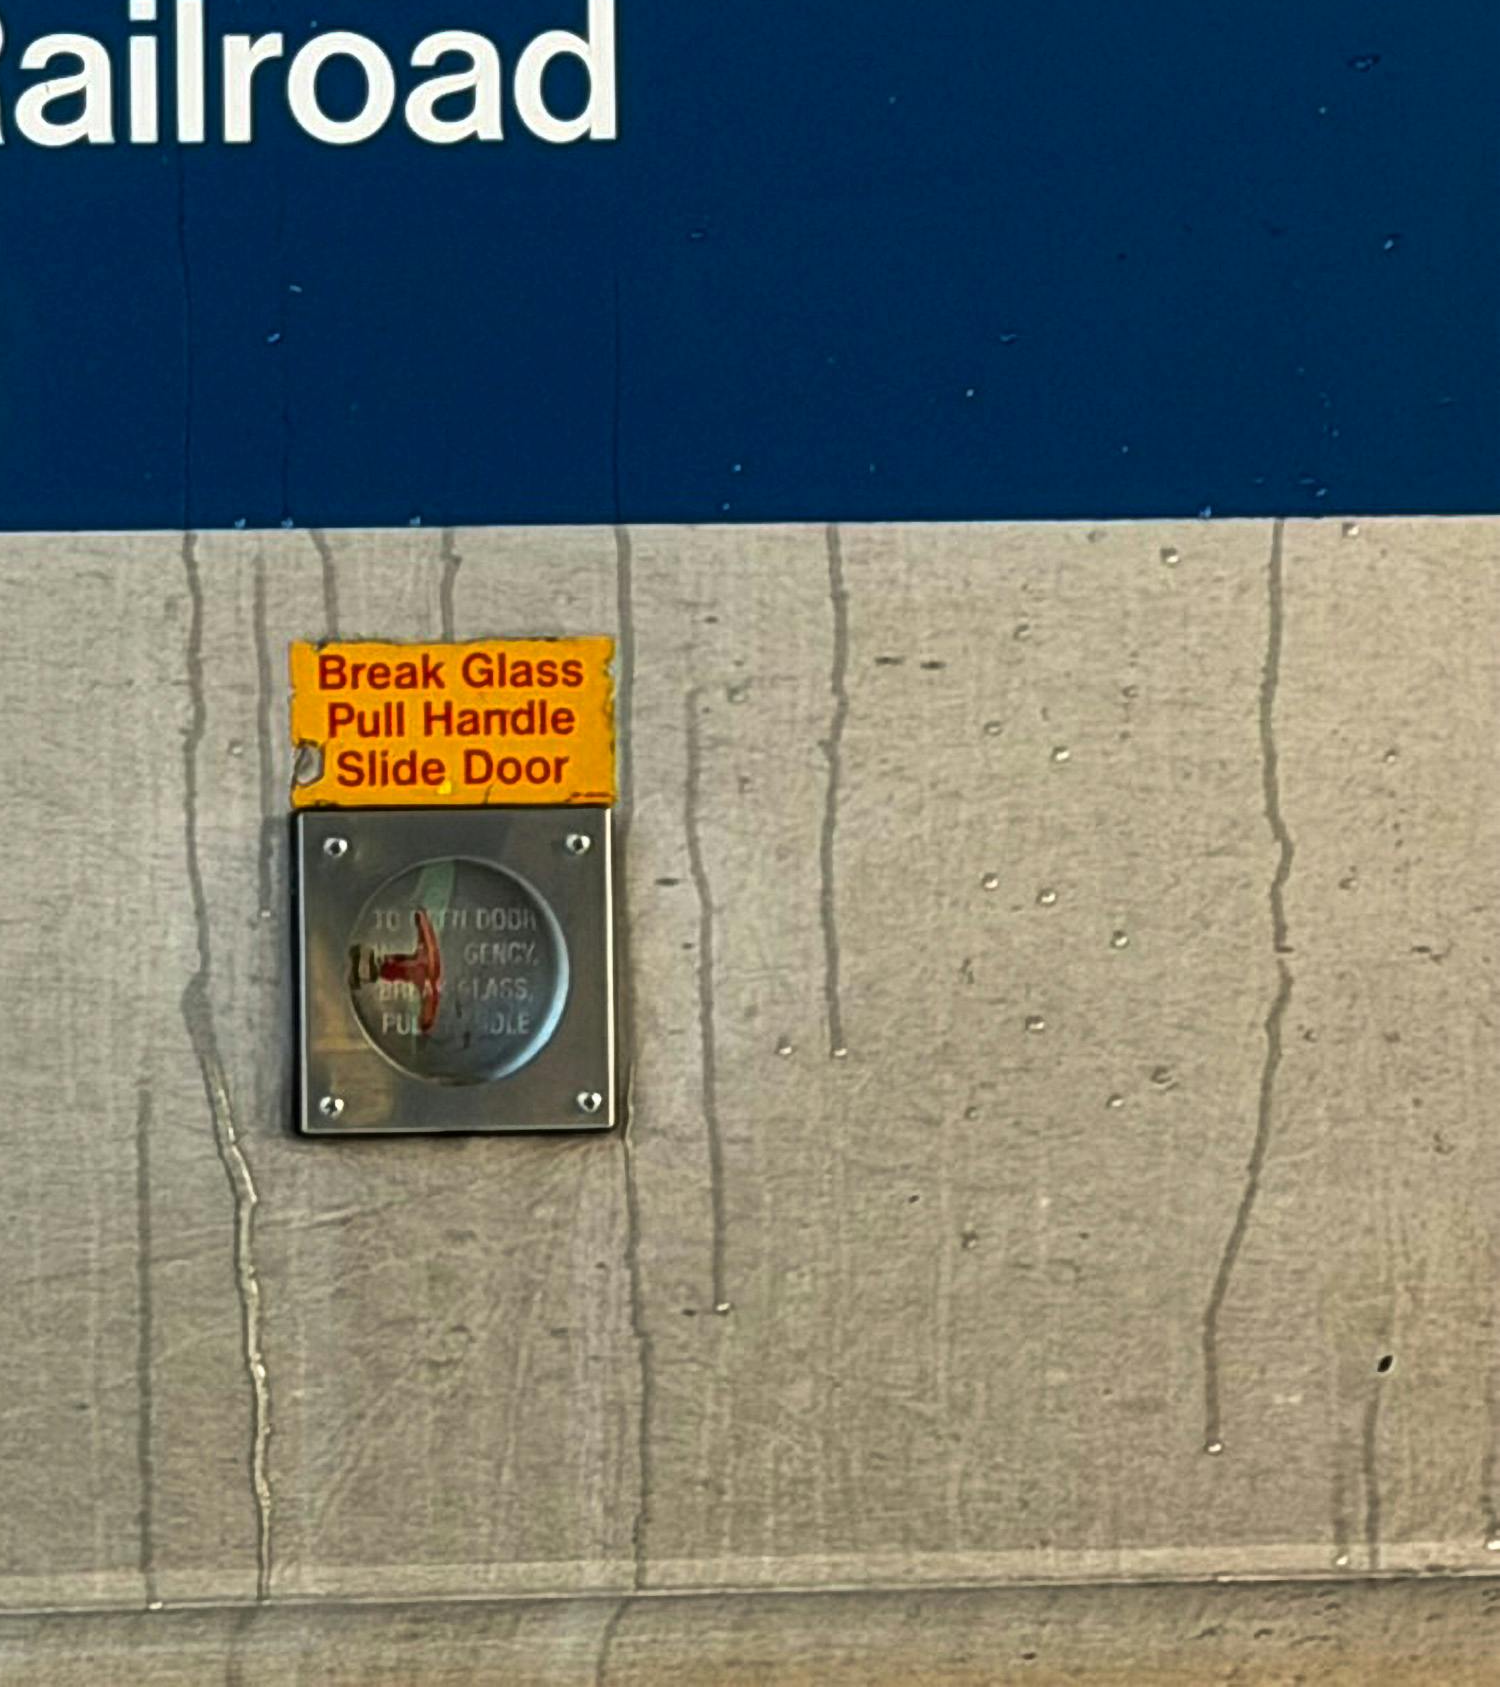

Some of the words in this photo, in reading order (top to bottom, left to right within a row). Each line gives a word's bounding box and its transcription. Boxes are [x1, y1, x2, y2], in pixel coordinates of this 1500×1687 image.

[318, 653, 445, 691] Break
[462, 652, 584, 689] Glass
[328, 700, 404, 738] Pull
[424, 699, 575, 736] Handle
[336, 749, 445, 787] Slide
[463, 748, 569, 785] Door
